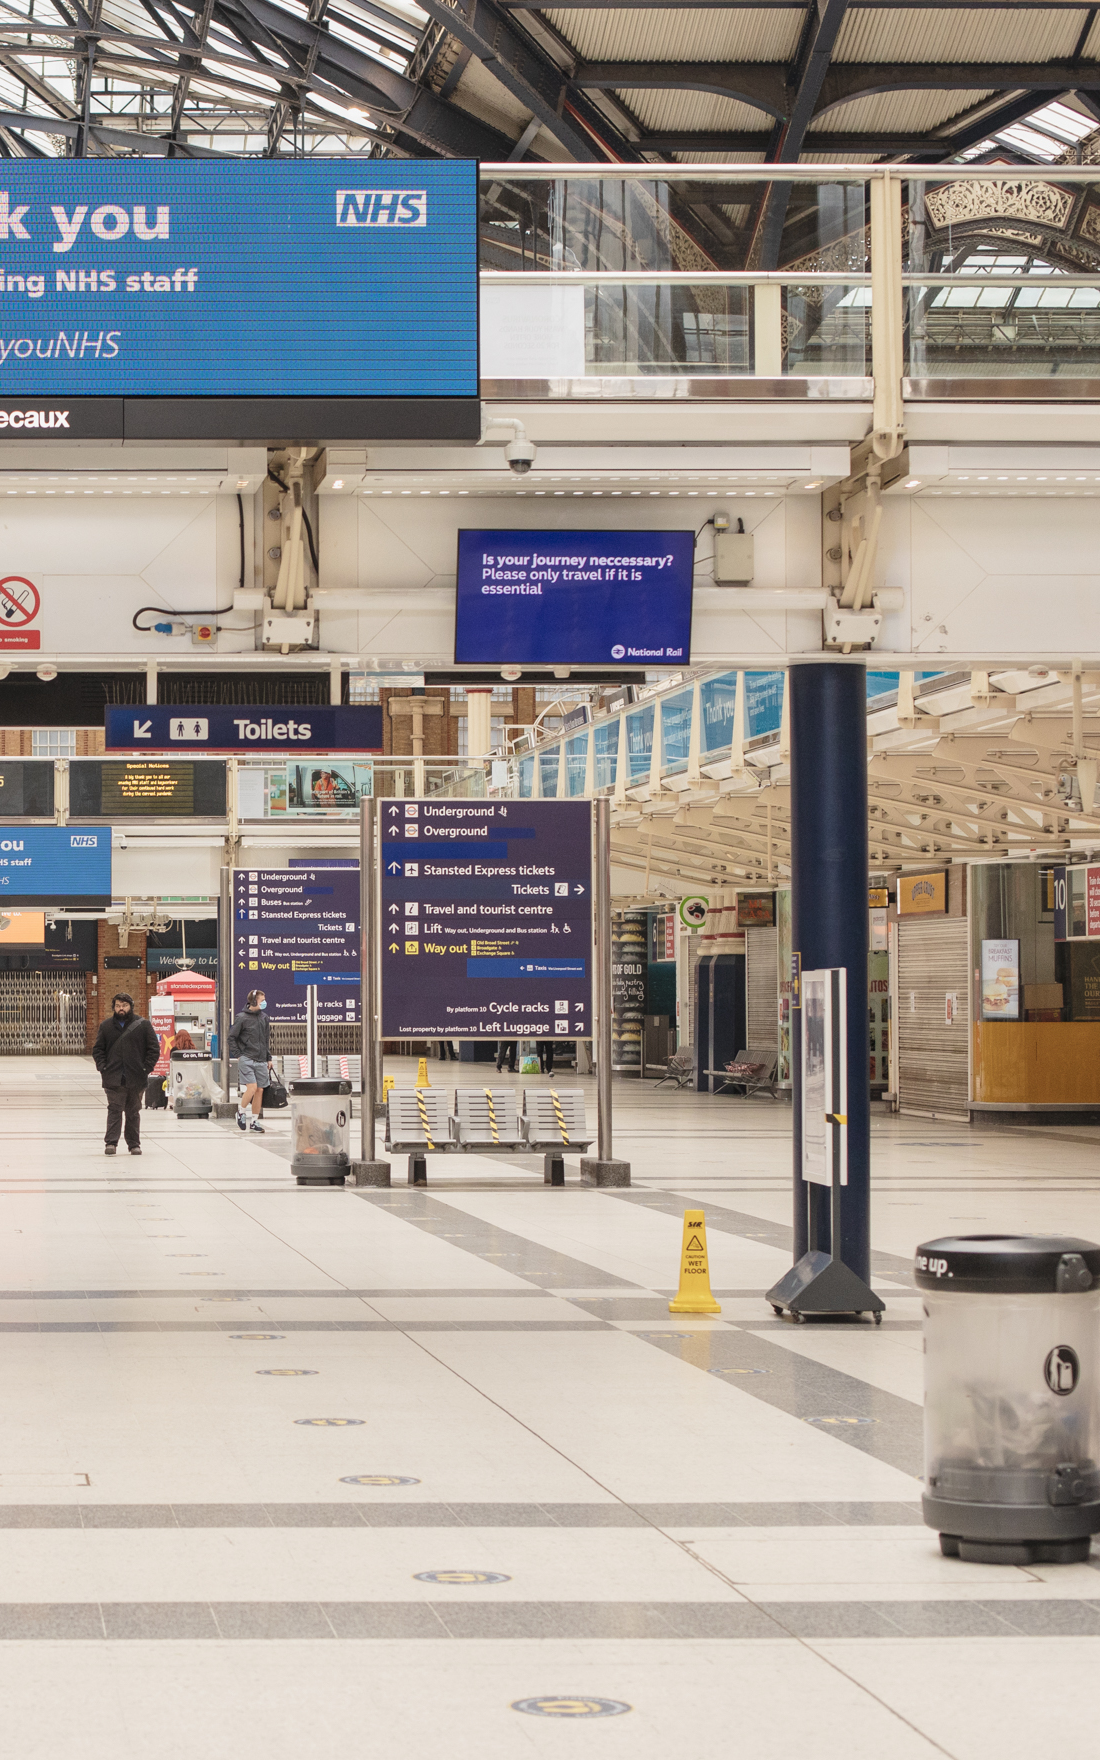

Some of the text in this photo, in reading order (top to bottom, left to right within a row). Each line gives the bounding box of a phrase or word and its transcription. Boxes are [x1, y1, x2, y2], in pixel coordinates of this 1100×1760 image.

[339, 192, 423, 224] NHS
[51, 203, 170, 253] you
[55, 270, 116, 292] NHS
[125, 268, 198, 292] staff
[483, 553, 673, 570] Is your journey neccessary?
[483, 567, 642, 584] Please only travel if it is
[482, 583, 542, 594] essential
[628, 648, 682, 656] National Rail
[234, 719, 311, 739] Toilets
[424, 806, 494, 818] Underground
[424, 826, 487, 838] Overground
[71, 836, 97, 846] NHS
[261, 873, 307, 881] Underground
[424, 865, 555, 877] Stansted Express tickets
[261, 886, 302, 894] Overground
[511, 885, 549, 894] Tickets
[1054, 879, 1066, 910] 10
[424, 904, 553, 914] Travel and tourist centre
[748, 900, 762, 909] MI
[740, 910, 771, 919] CASA
[425, 923, 442, 933] Lift
[424, 943, 467, 955] Way out
[623, 964, 642, 975] GOLD
[489, 1002, 518, 1014] Cycle
[522, 1002, 549, 1012] racks
[480, 1022, 501, 1032] Left
[504, 1022, 549, 1034] Luggage
[928, 1258, 954, 1277] up.
